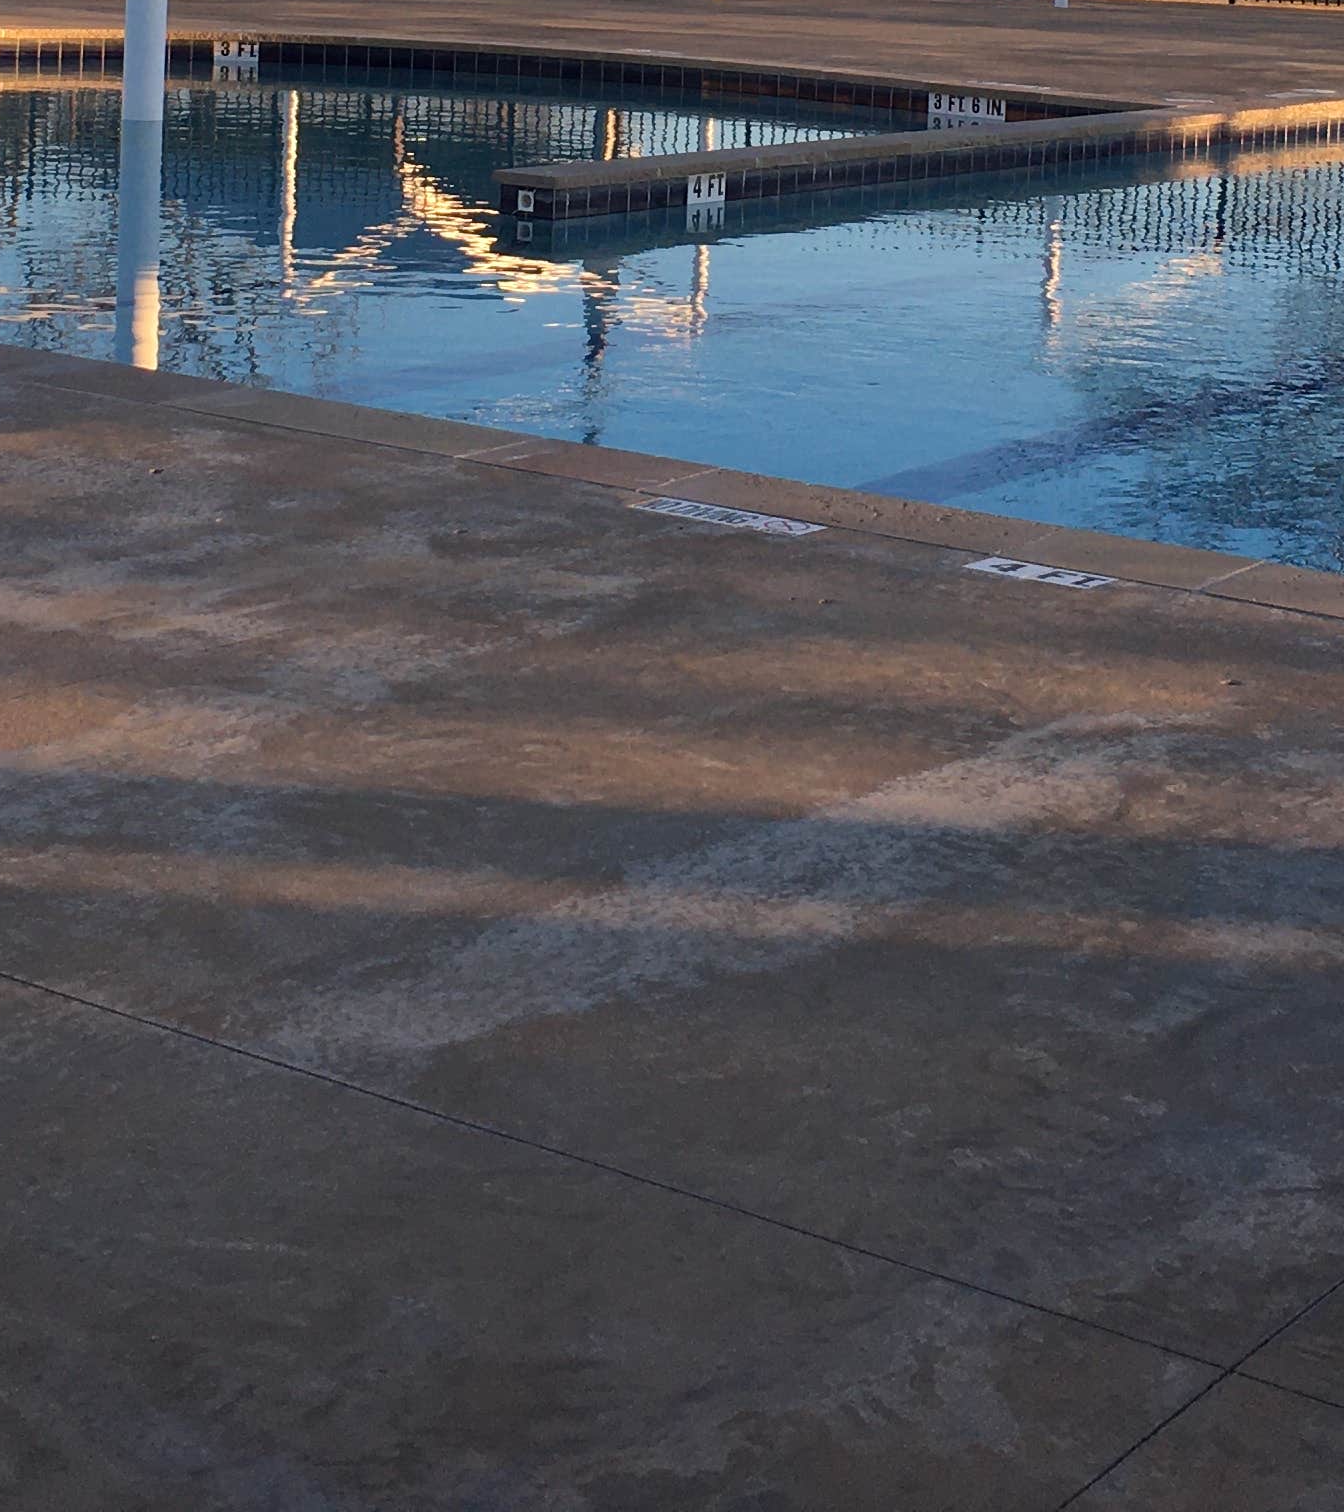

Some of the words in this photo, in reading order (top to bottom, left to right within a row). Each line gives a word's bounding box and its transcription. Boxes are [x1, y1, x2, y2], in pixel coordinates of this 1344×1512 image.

[221, 40, 230, 56] 3
[933, 93, 942, 109] 3
[972, 96, 980, 113] 6
[693, 175, 702, 198] 4
[990, 563, 1028, 572] 4
